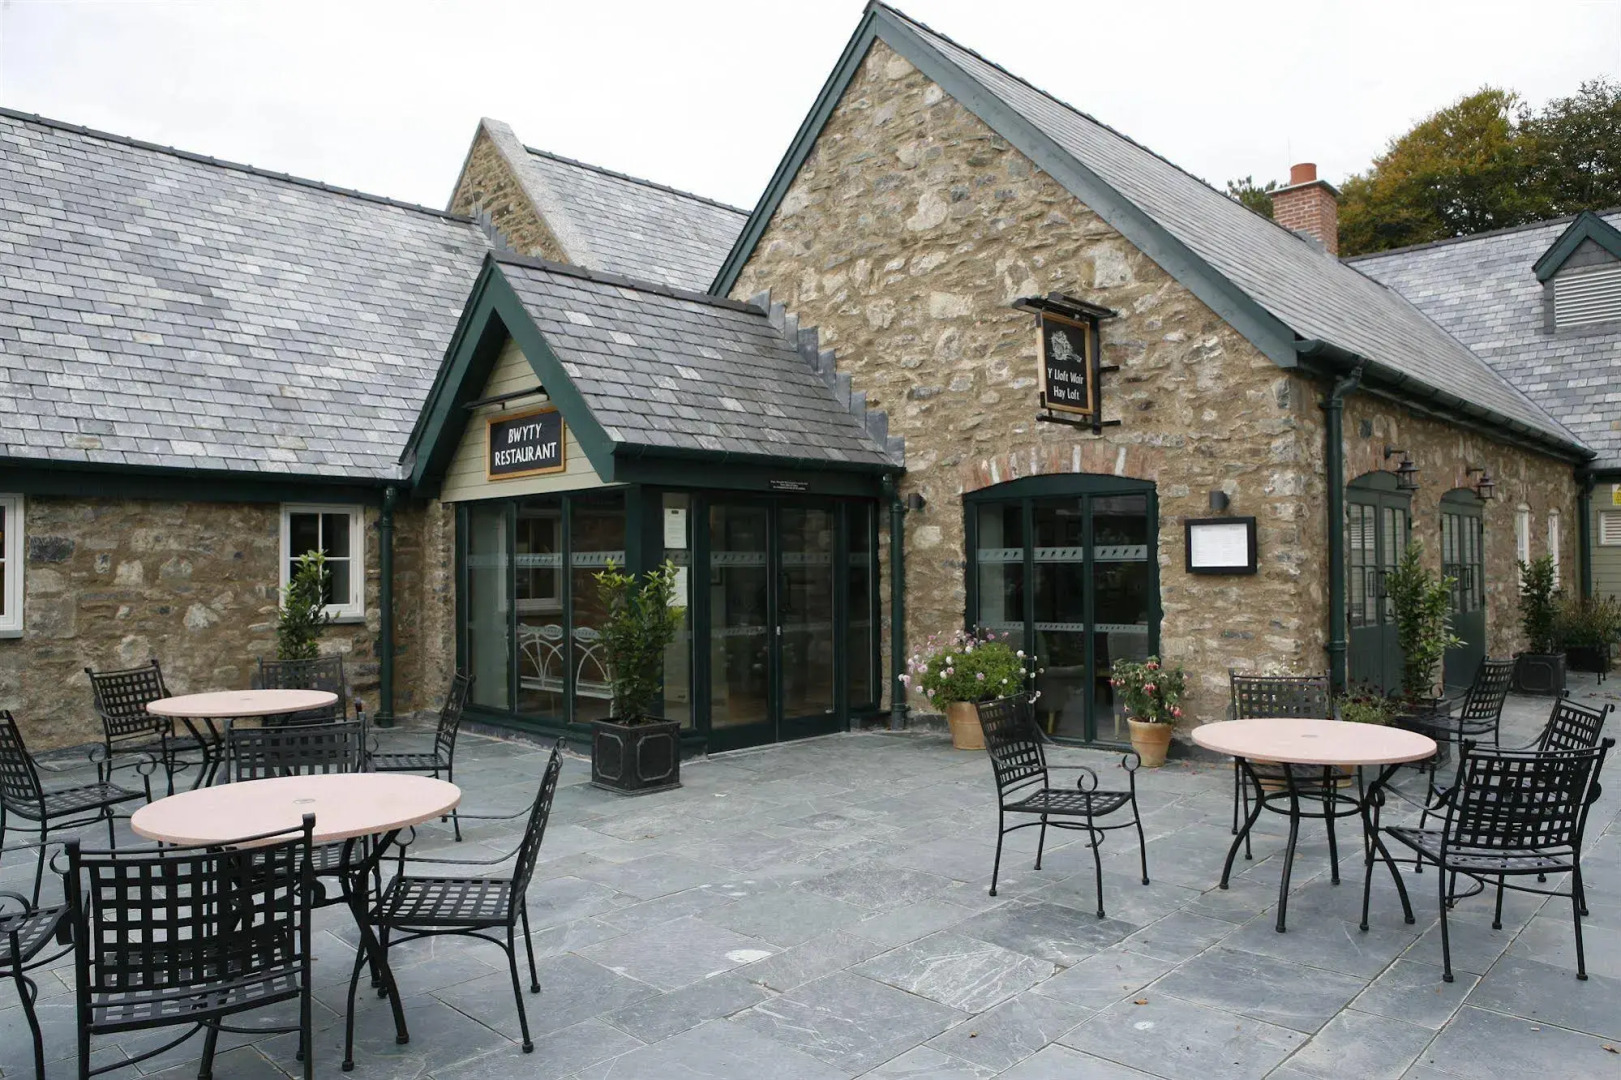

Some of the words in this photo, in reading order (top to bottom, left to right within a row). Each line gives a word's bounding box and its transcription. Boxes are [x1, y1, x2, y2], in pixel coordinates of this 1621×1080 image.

[1047, 367, 1053, 379] Y
[1070, 372, 1084, 385] Wair
[1053, 385, 1066, 400] Hay
[1067, 387, 1080, 400] Loft
[508, 423, 542, 444] BWYTY
[494, 442, 557, 466] RESTAURANT
